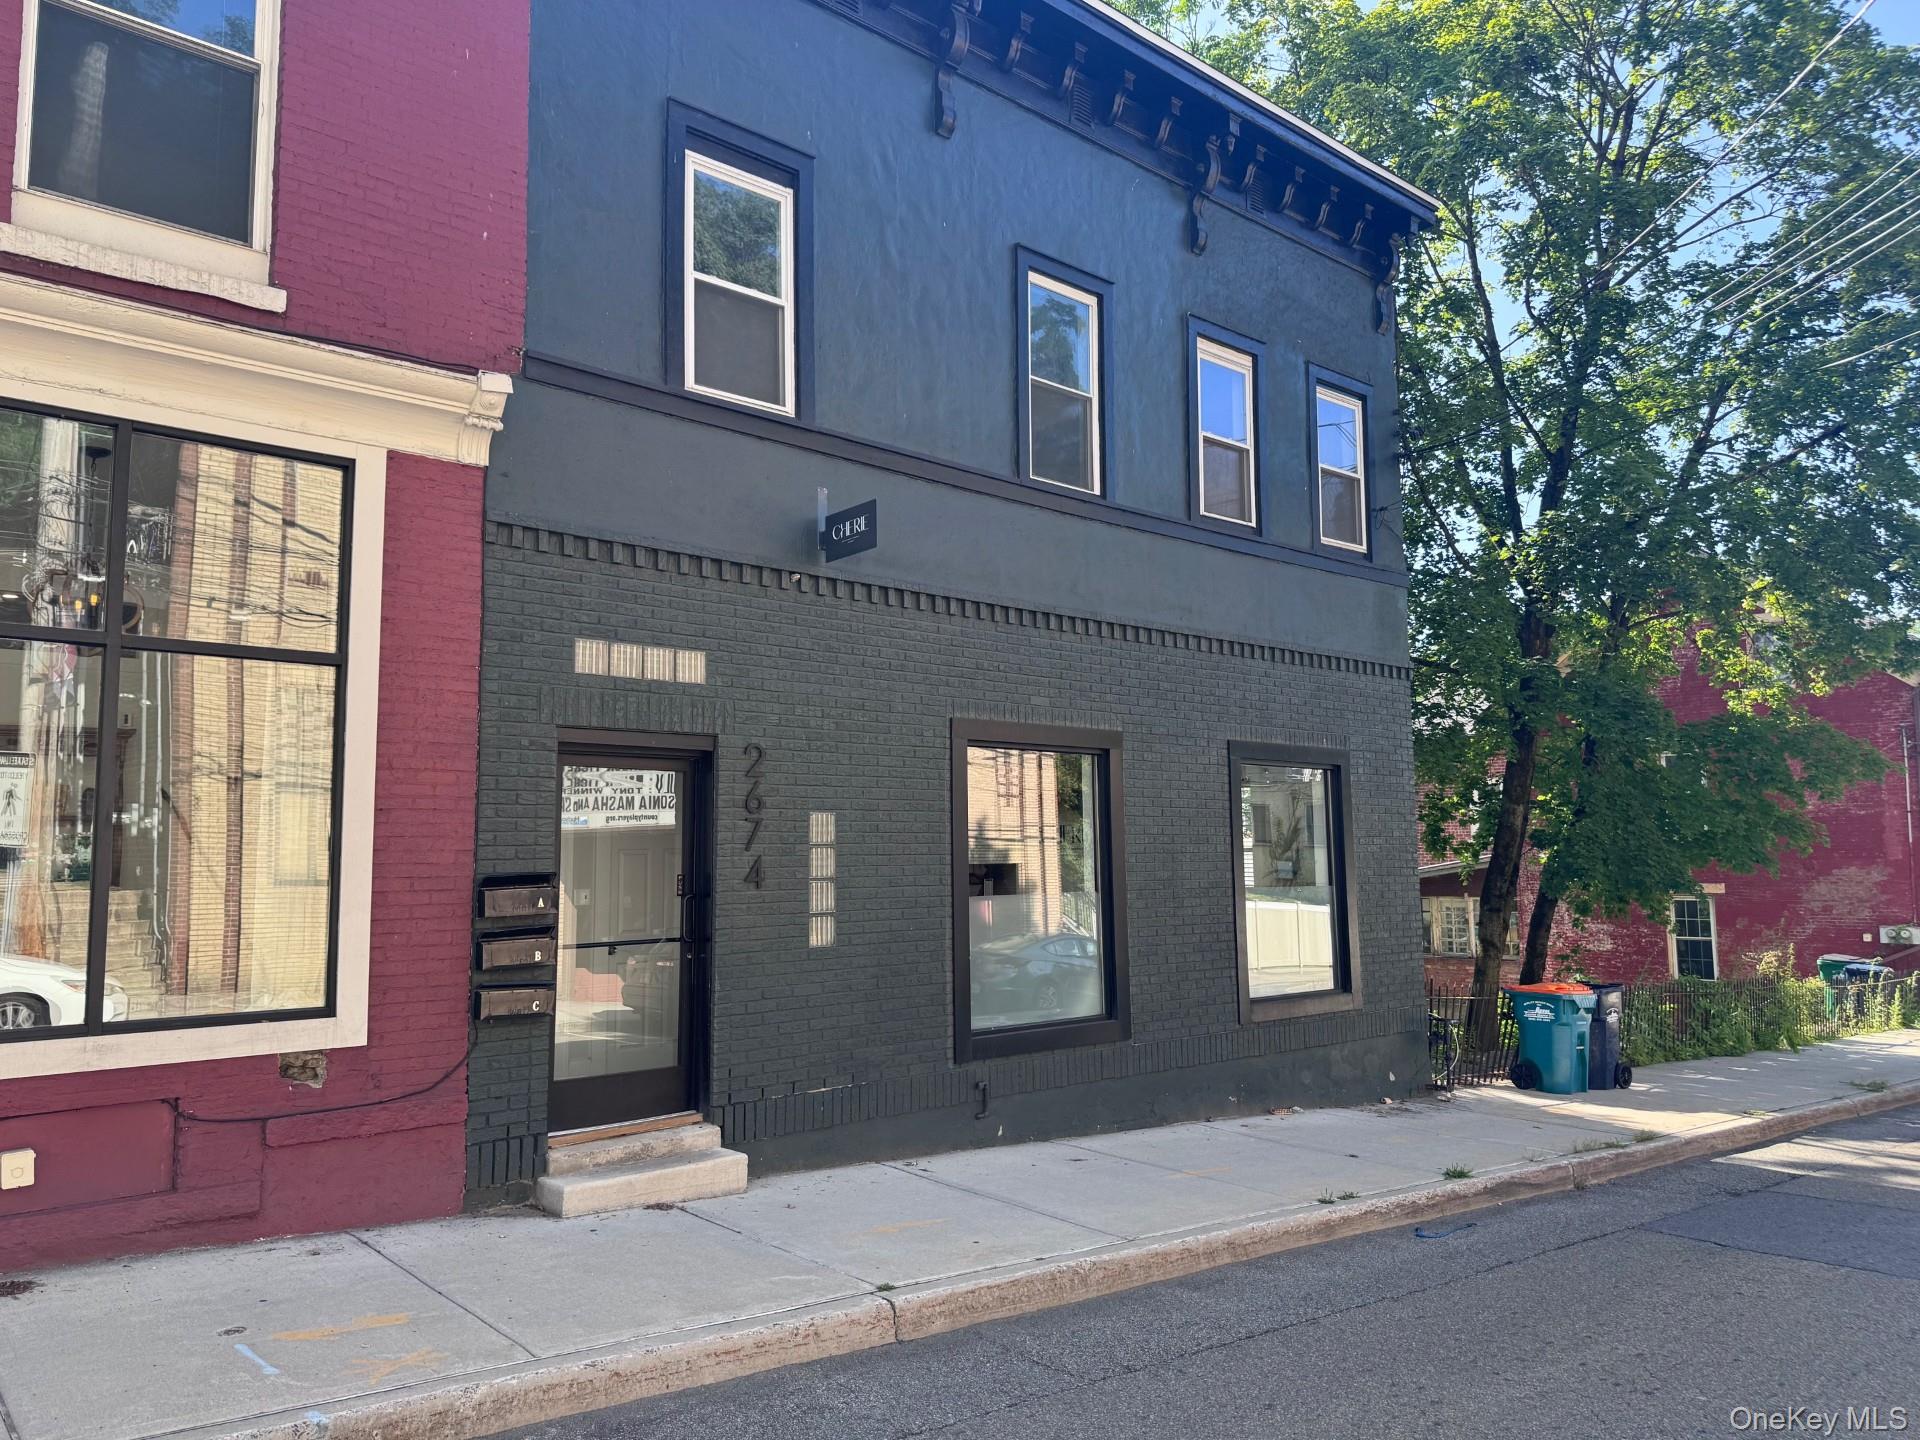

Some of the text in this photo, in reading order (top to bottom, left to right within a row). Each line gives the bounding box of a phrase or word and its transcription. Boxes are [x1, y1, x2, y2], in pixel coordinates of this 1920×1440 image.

[832, 514, 869, 540] CHERIE
[744, 743, 764, 889] 2674
[537, 897, 545, 908] A
[534, 951, 542, 961] B
[532, 1001, 540, 1011] C
